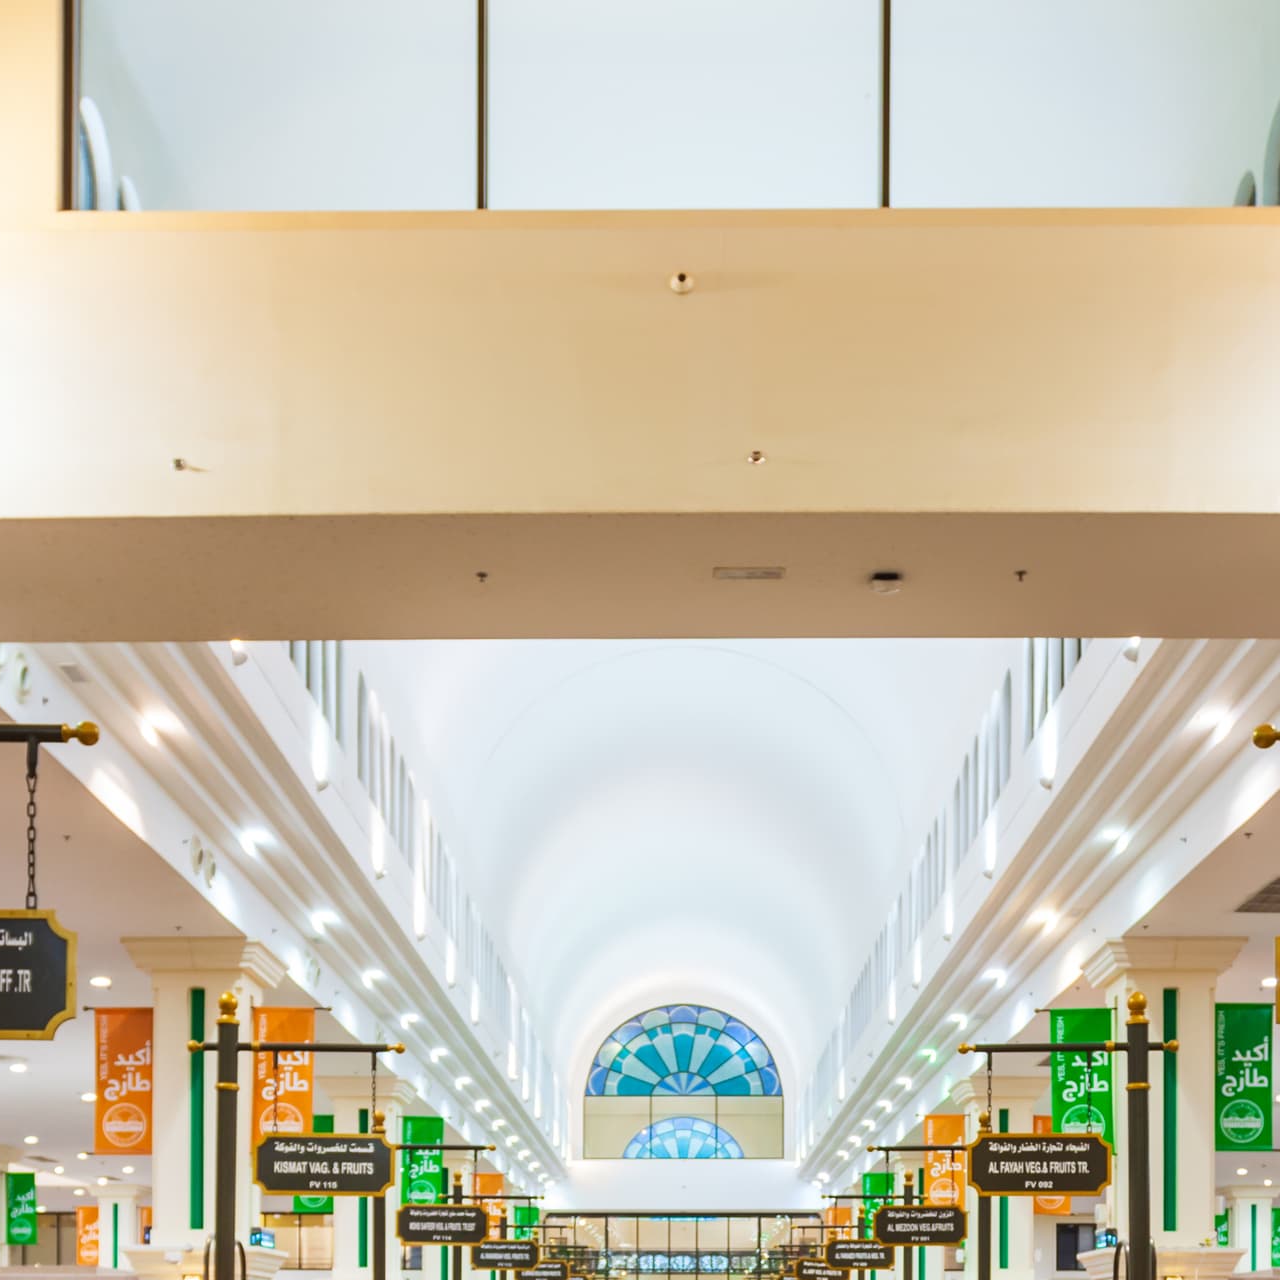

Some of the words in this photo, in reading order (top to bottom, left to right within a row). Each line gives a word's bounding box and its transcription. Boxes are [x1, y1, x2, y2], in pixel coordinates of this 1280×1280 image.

[114, 1040, 152, 1071] أكيد
[1231, 1035, 1269, 1066] أكيد
[103, 1071, 152, 1101] طازج
[1221, 1067, 1269, 1097] طازج
[273, 1161, 308, 1174] KISMAT
[308, 1161, 331, 1174] VAG.
[332, 1162, 340, 1174] &
[340, 1162, 374, 1175] FRUITS
[988, 1161, 999, 1173] AL
[999, 1161, 1024, 1174] FAYAH
[1048, 1161, 1076, 1174] FRUITS
